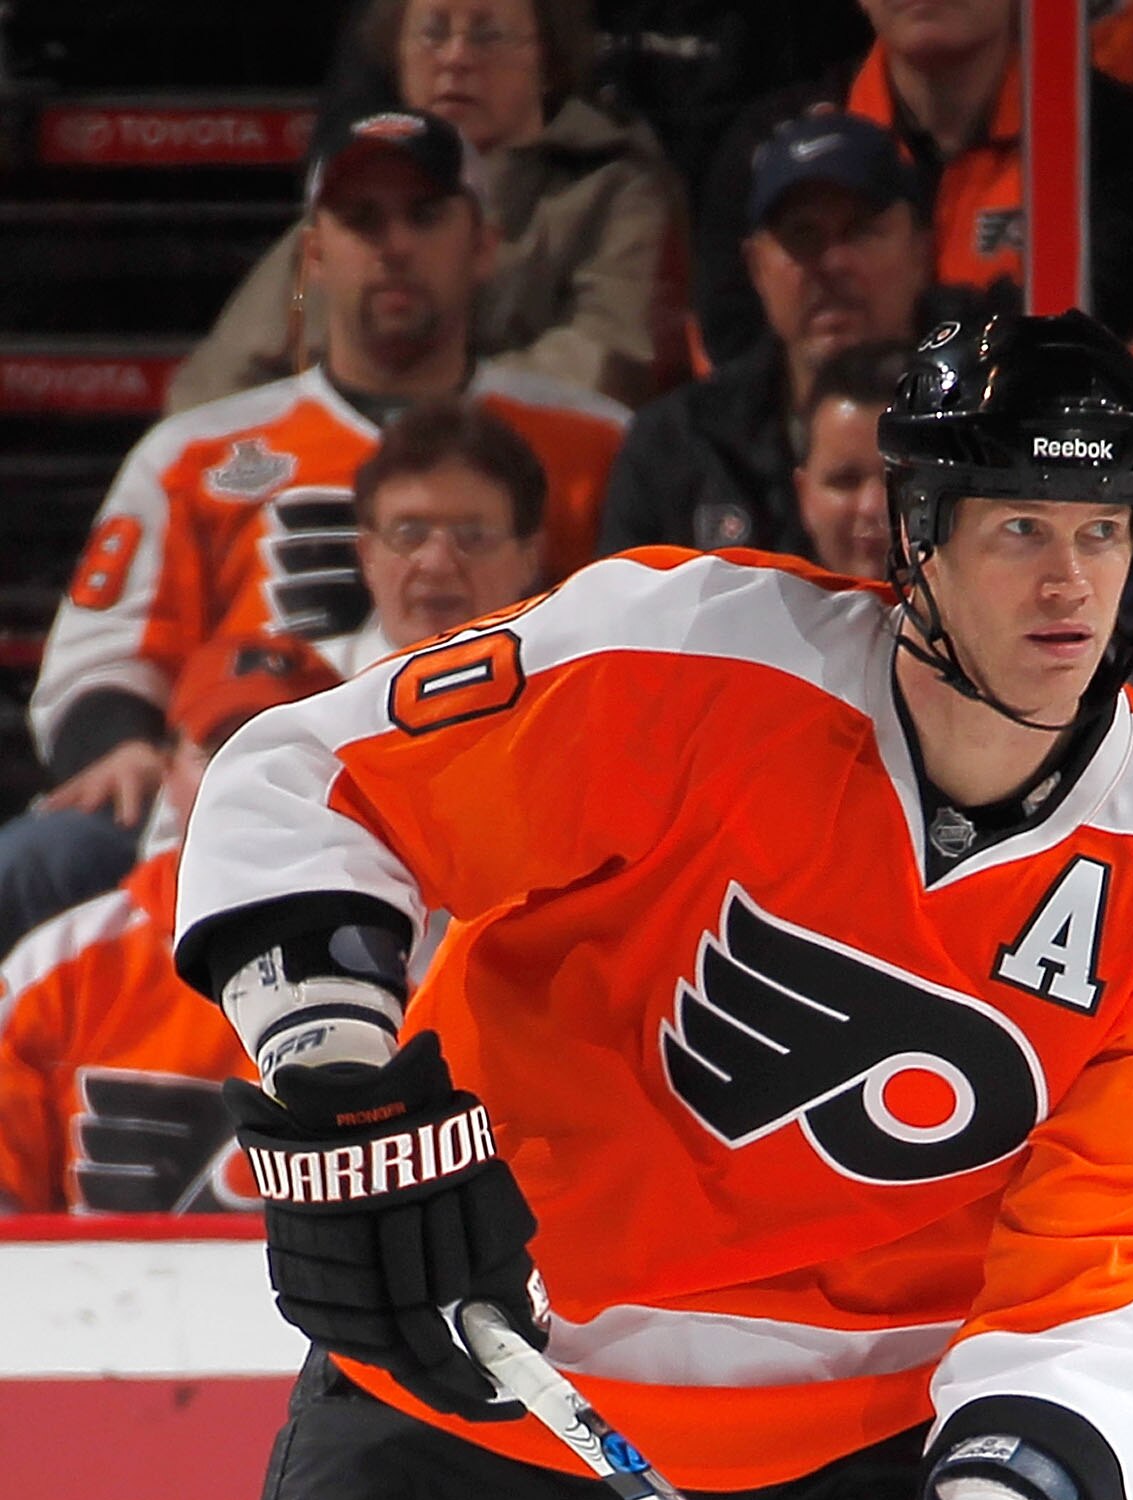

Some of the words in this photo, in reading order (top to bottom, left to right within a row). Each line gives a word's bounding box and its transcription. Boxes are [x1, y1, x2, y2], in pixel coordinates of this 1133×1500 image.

[119, 117, 265, 145] TOYOTA
[1033, 437, 1114, 460] Reebok
[989, 853, 1113, 1017] A
[249, 1104, 497, 1202] WARRIOR
